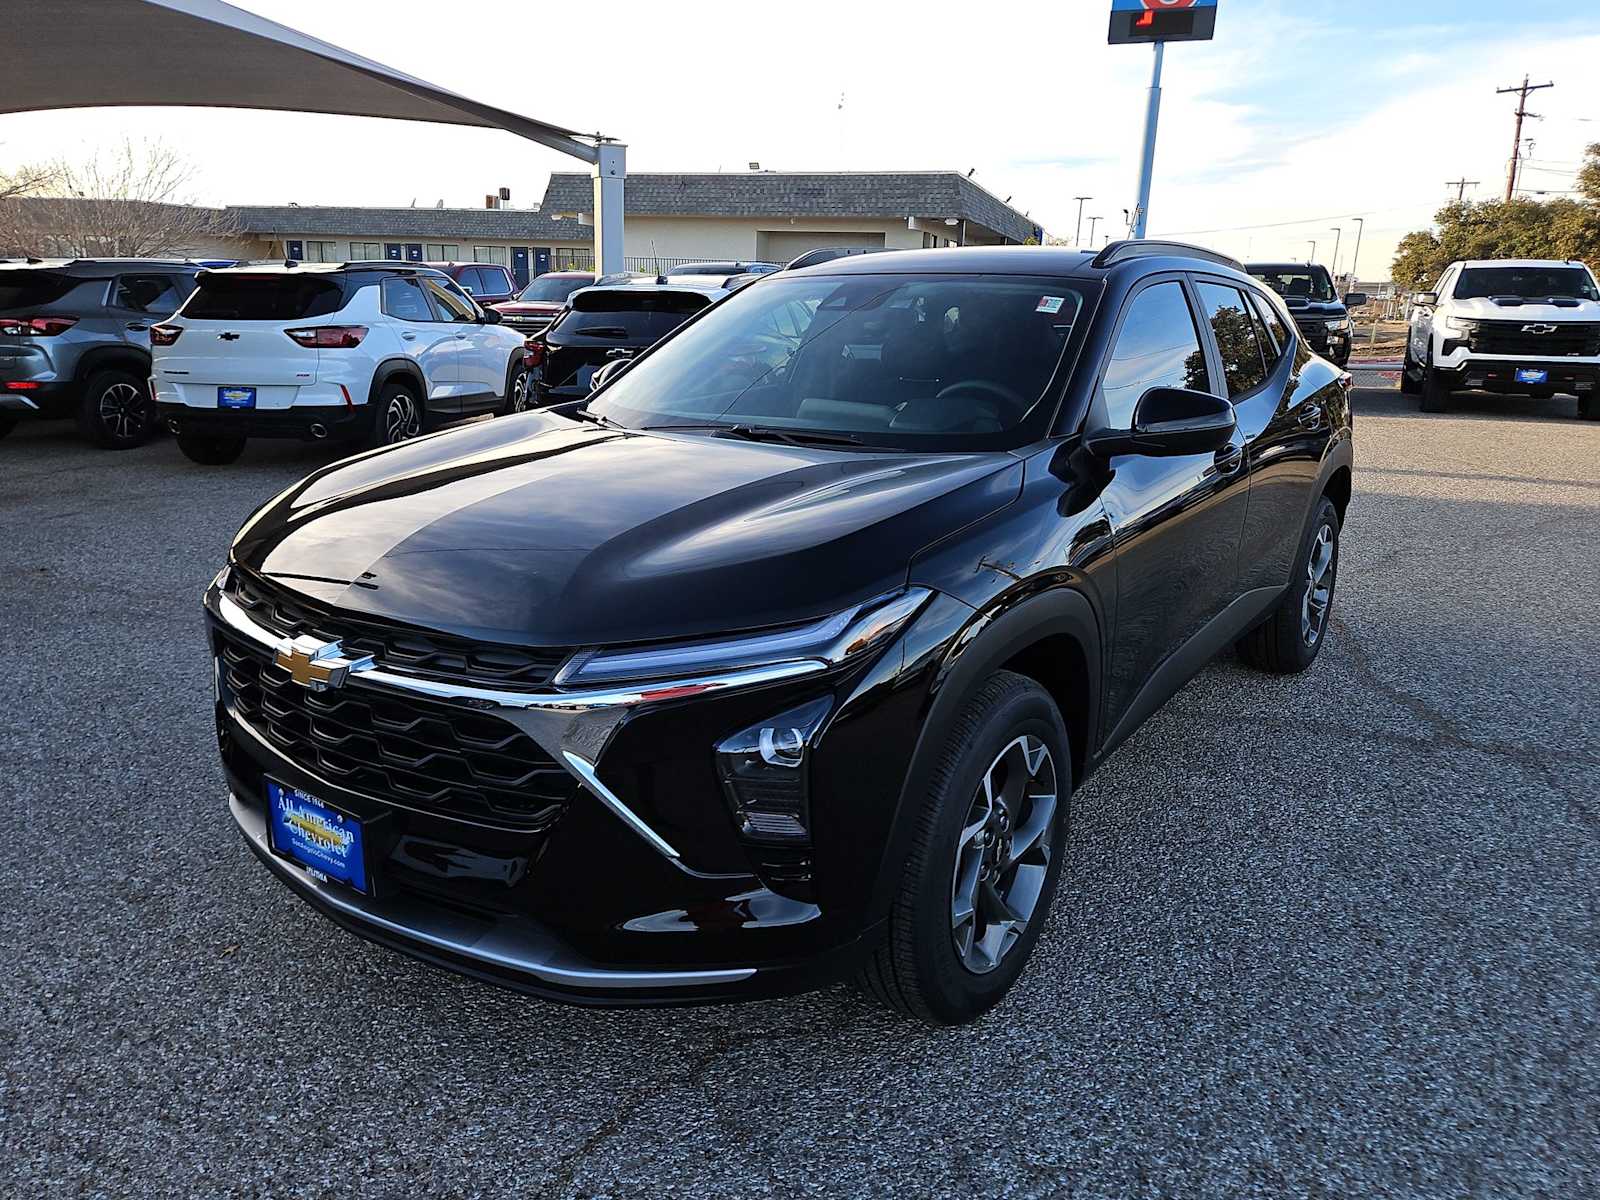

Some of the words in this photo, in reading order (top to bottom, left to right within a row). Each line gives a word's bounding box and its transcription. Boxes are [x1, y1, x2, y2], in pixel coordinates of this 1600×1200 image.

[294, 789, 312, 803] SINCE
[278, 796, 294, 814] All
[297, 805, 354, 844] American
[289, 820, 348, 858] Chevrolet
